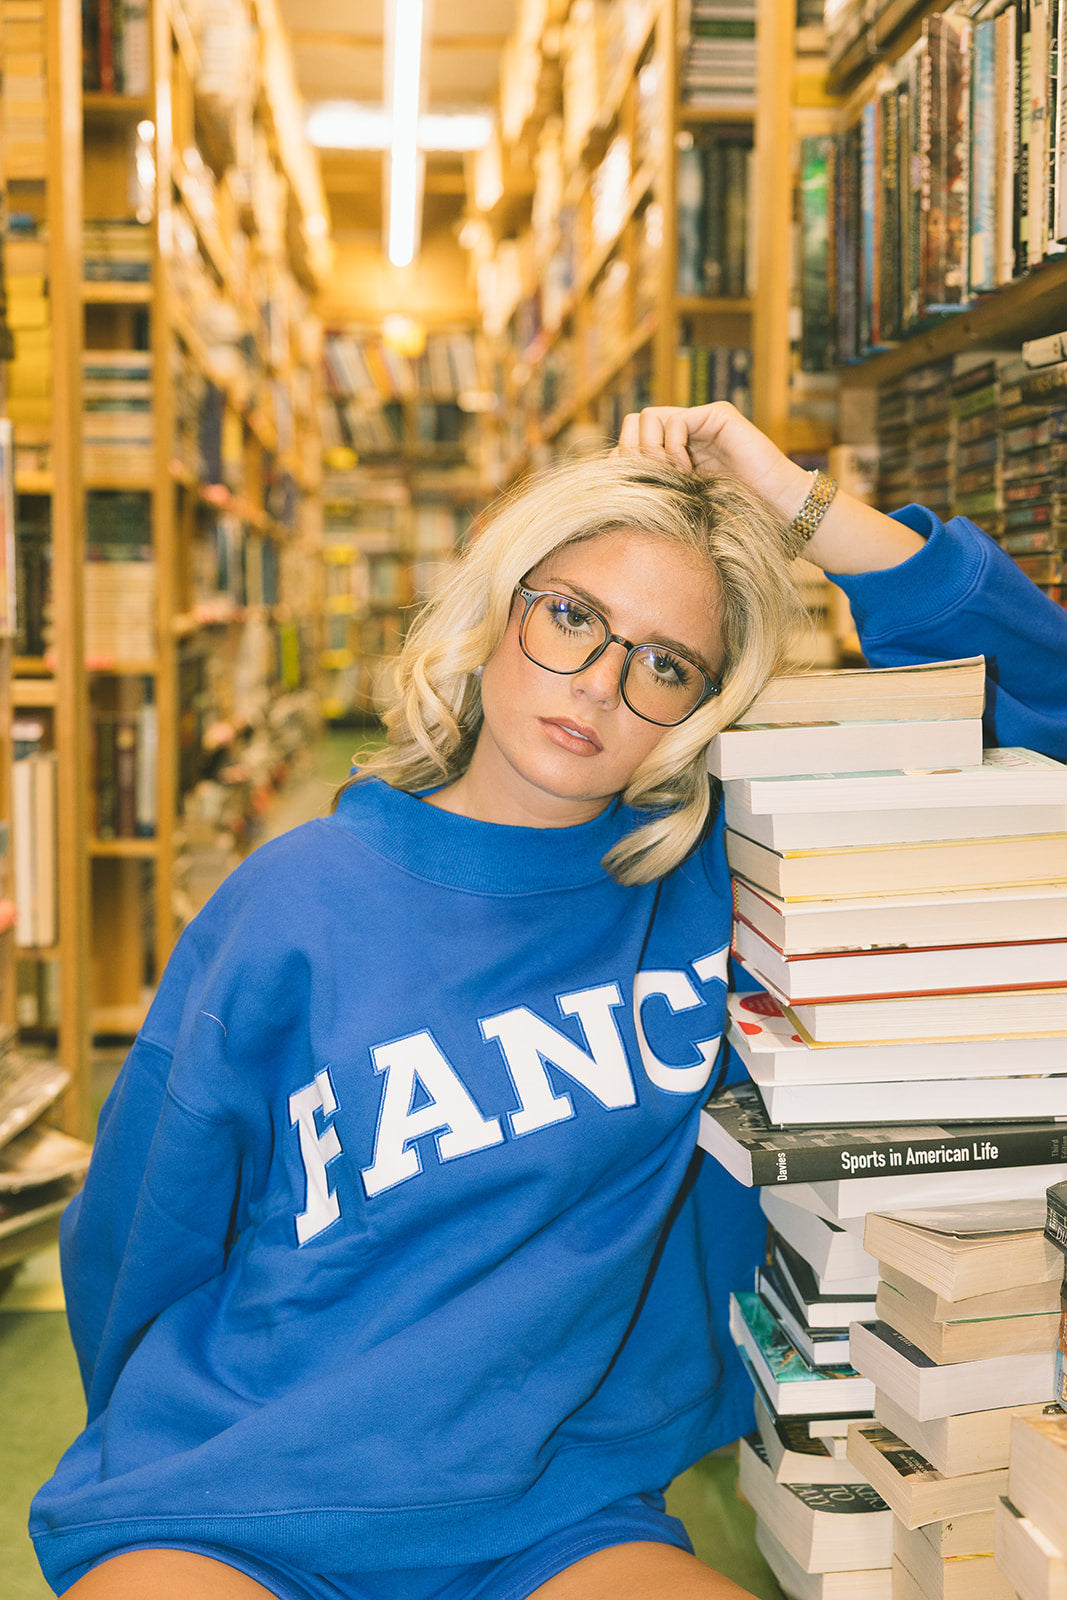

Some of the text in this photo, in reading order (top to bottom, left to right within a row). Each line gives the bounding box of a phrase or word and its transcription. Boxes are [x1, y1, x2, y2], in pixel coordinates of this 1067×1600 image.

[288, 943, 728, 1247] FANC
[841, 1142, 999, 1174] Sports in American Life
[1051, 1139, 1059, 1157] Third
[776, 1152, 788, 1181] Davies
[823, 1485, 855, 1502] TO
